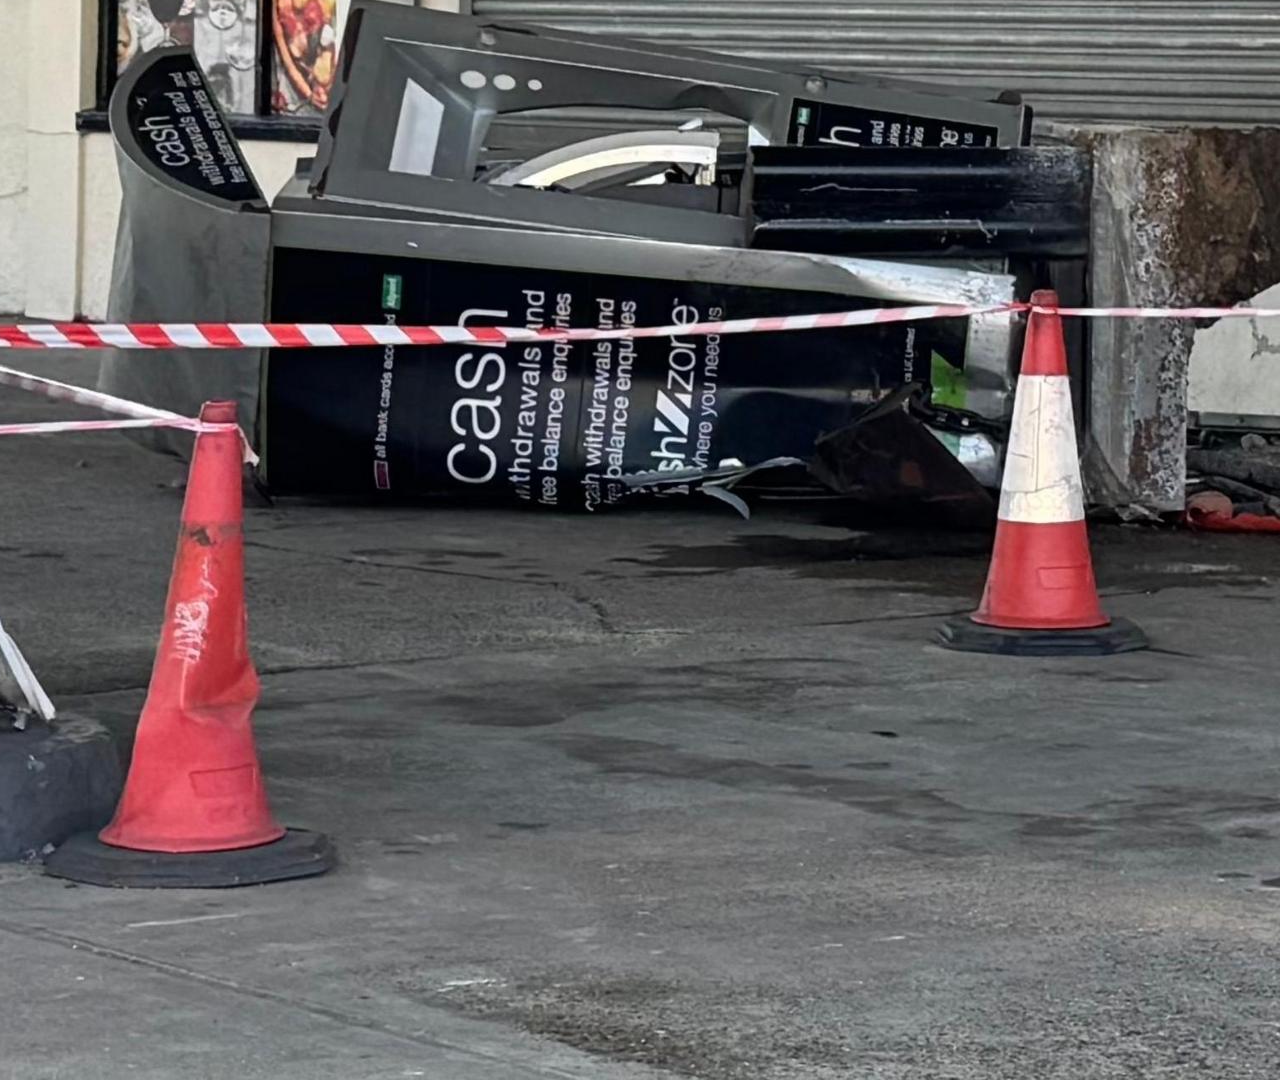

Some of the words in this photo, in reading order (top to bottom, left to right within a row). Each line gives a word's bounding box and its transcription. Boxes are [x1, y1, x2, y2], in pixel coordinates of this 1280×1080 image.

[163, 91, 191, 114] and
[193, 89, 222, 129] enquiries
[138, 115, 190, 167] cash
[179, 116, 226, 186] withdrawals
[212, 129, 239, 166] balance
[551, 292, 573, 382] enqries
[379, 372, 394, 408] cards
[446, 307, 509, 484] cash
[584, 342, 611, 466] withdrawals
[701, 382, 718, 416] you
[376, 410, 389, 442] bank
[539, 388, 564, 470] balance
[602, 396, 630, 479] balance
